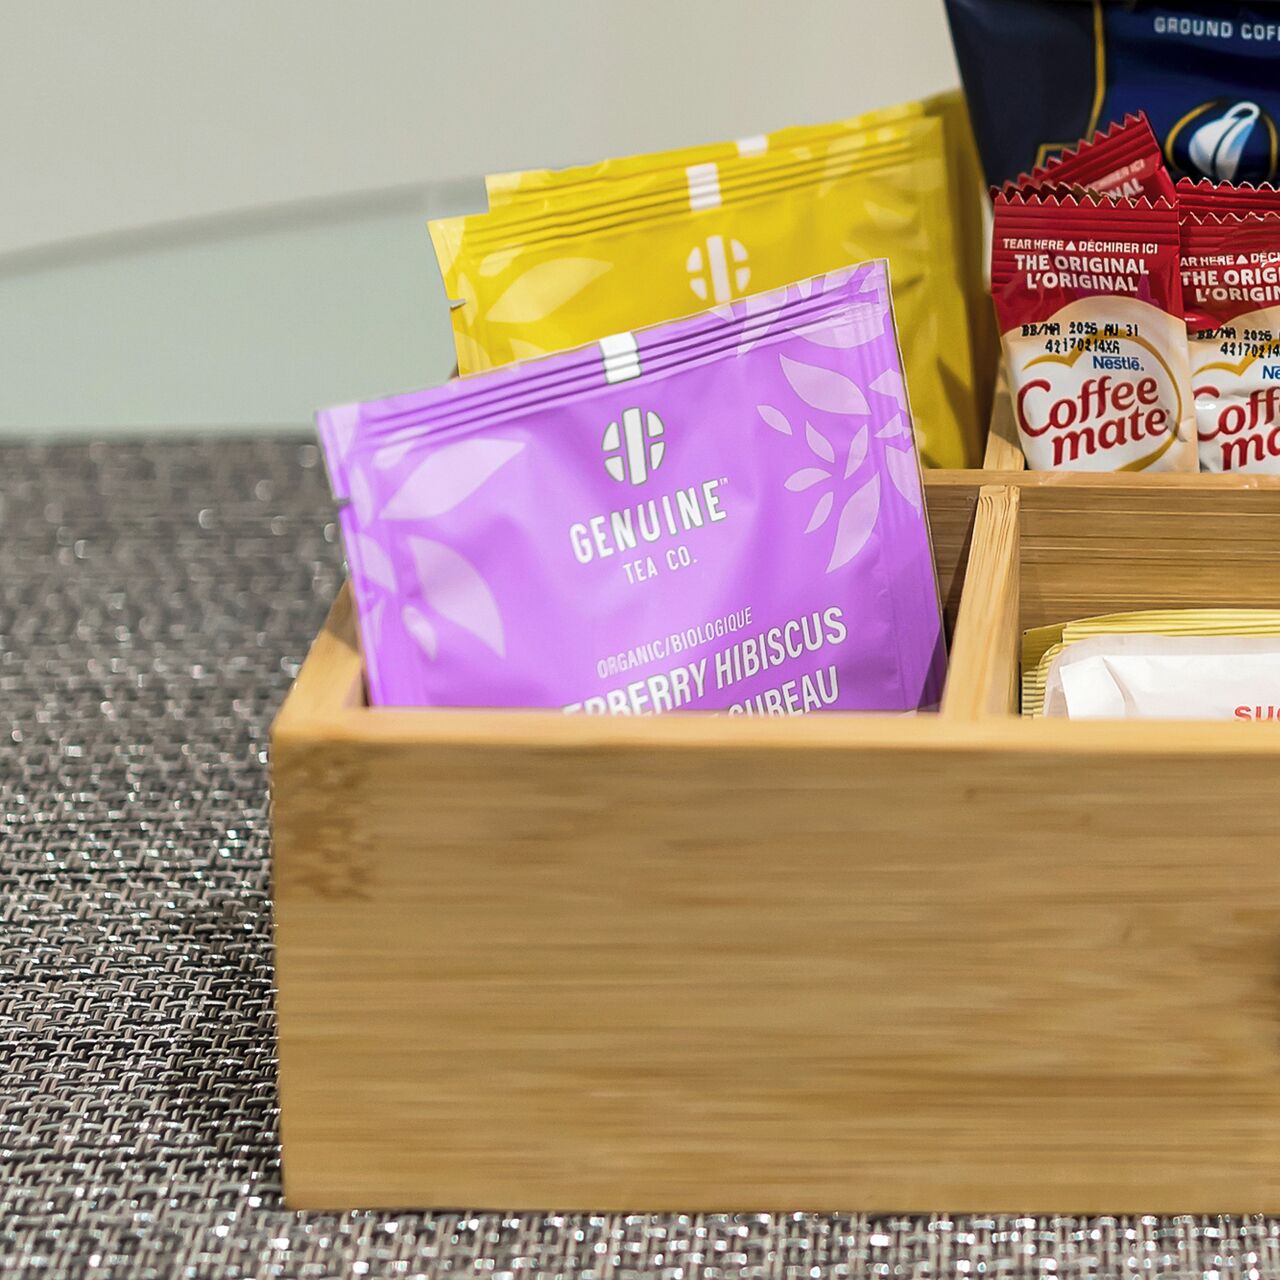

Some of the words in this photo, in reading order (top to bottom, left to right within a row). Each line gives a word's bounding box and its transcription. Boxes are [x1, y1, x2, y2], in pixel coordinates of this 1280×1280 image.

[1154, 16, 1233, 38] GROUND
[1003, 238, 1031, 250] TEAR
[1034, 239, 1064, 251] HERE
[1079, 239, 1139, 254] DÉCHIRER
[1143, 243, 1158, 254] ICI
[1014, 254, 1050, 270] THE
[1054, 256, 1149, 275] ORIGINAL
[1200, 254, 1234, 266] HERE
[1027, 272, 1138, 291] L'ORIGINAL
[1181, 271, 1218, 286] THE
[1104, 324, 1119, 336] AU
[1126, 324, 1138, 337] 31
[1017, 375, 1159, 437] Coffee
[1052, 406, 1168, 467] mate
[622, 556, 658, 584] TEA
[666, 545, 697, 570] CO.
[597, 606, 753, 679] ORGANIC/BIOLOGIQUE
[715, 606, 848, 689] HIBISCUS
